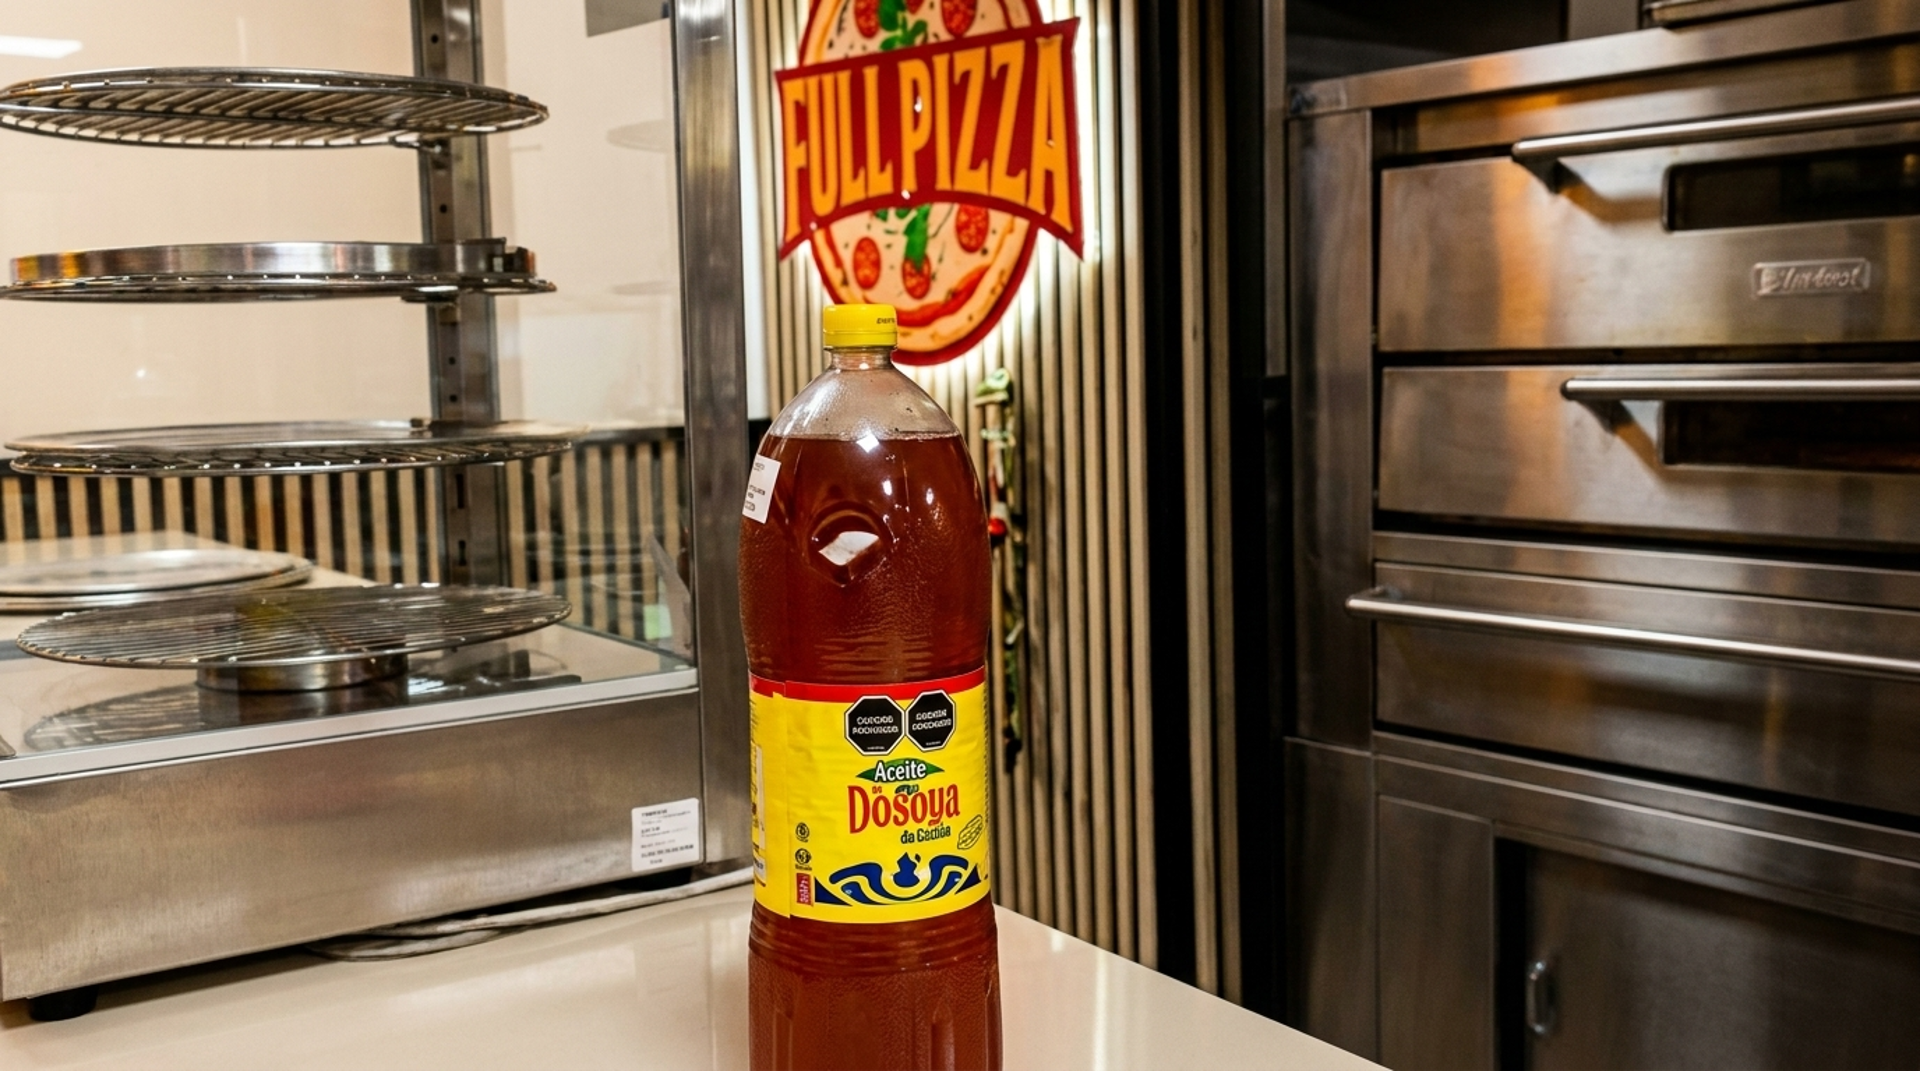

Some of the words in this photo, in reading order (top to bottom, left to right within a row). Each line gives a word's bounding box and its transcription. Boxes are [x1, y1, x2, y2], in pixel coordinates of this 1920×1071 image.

[781, 65, 894, 243] FULL
[898, 34, 1073, 234] PIZZA
[874, 760, 927, 782] Aceite
[847, 784, 961, 834] Dosoya
